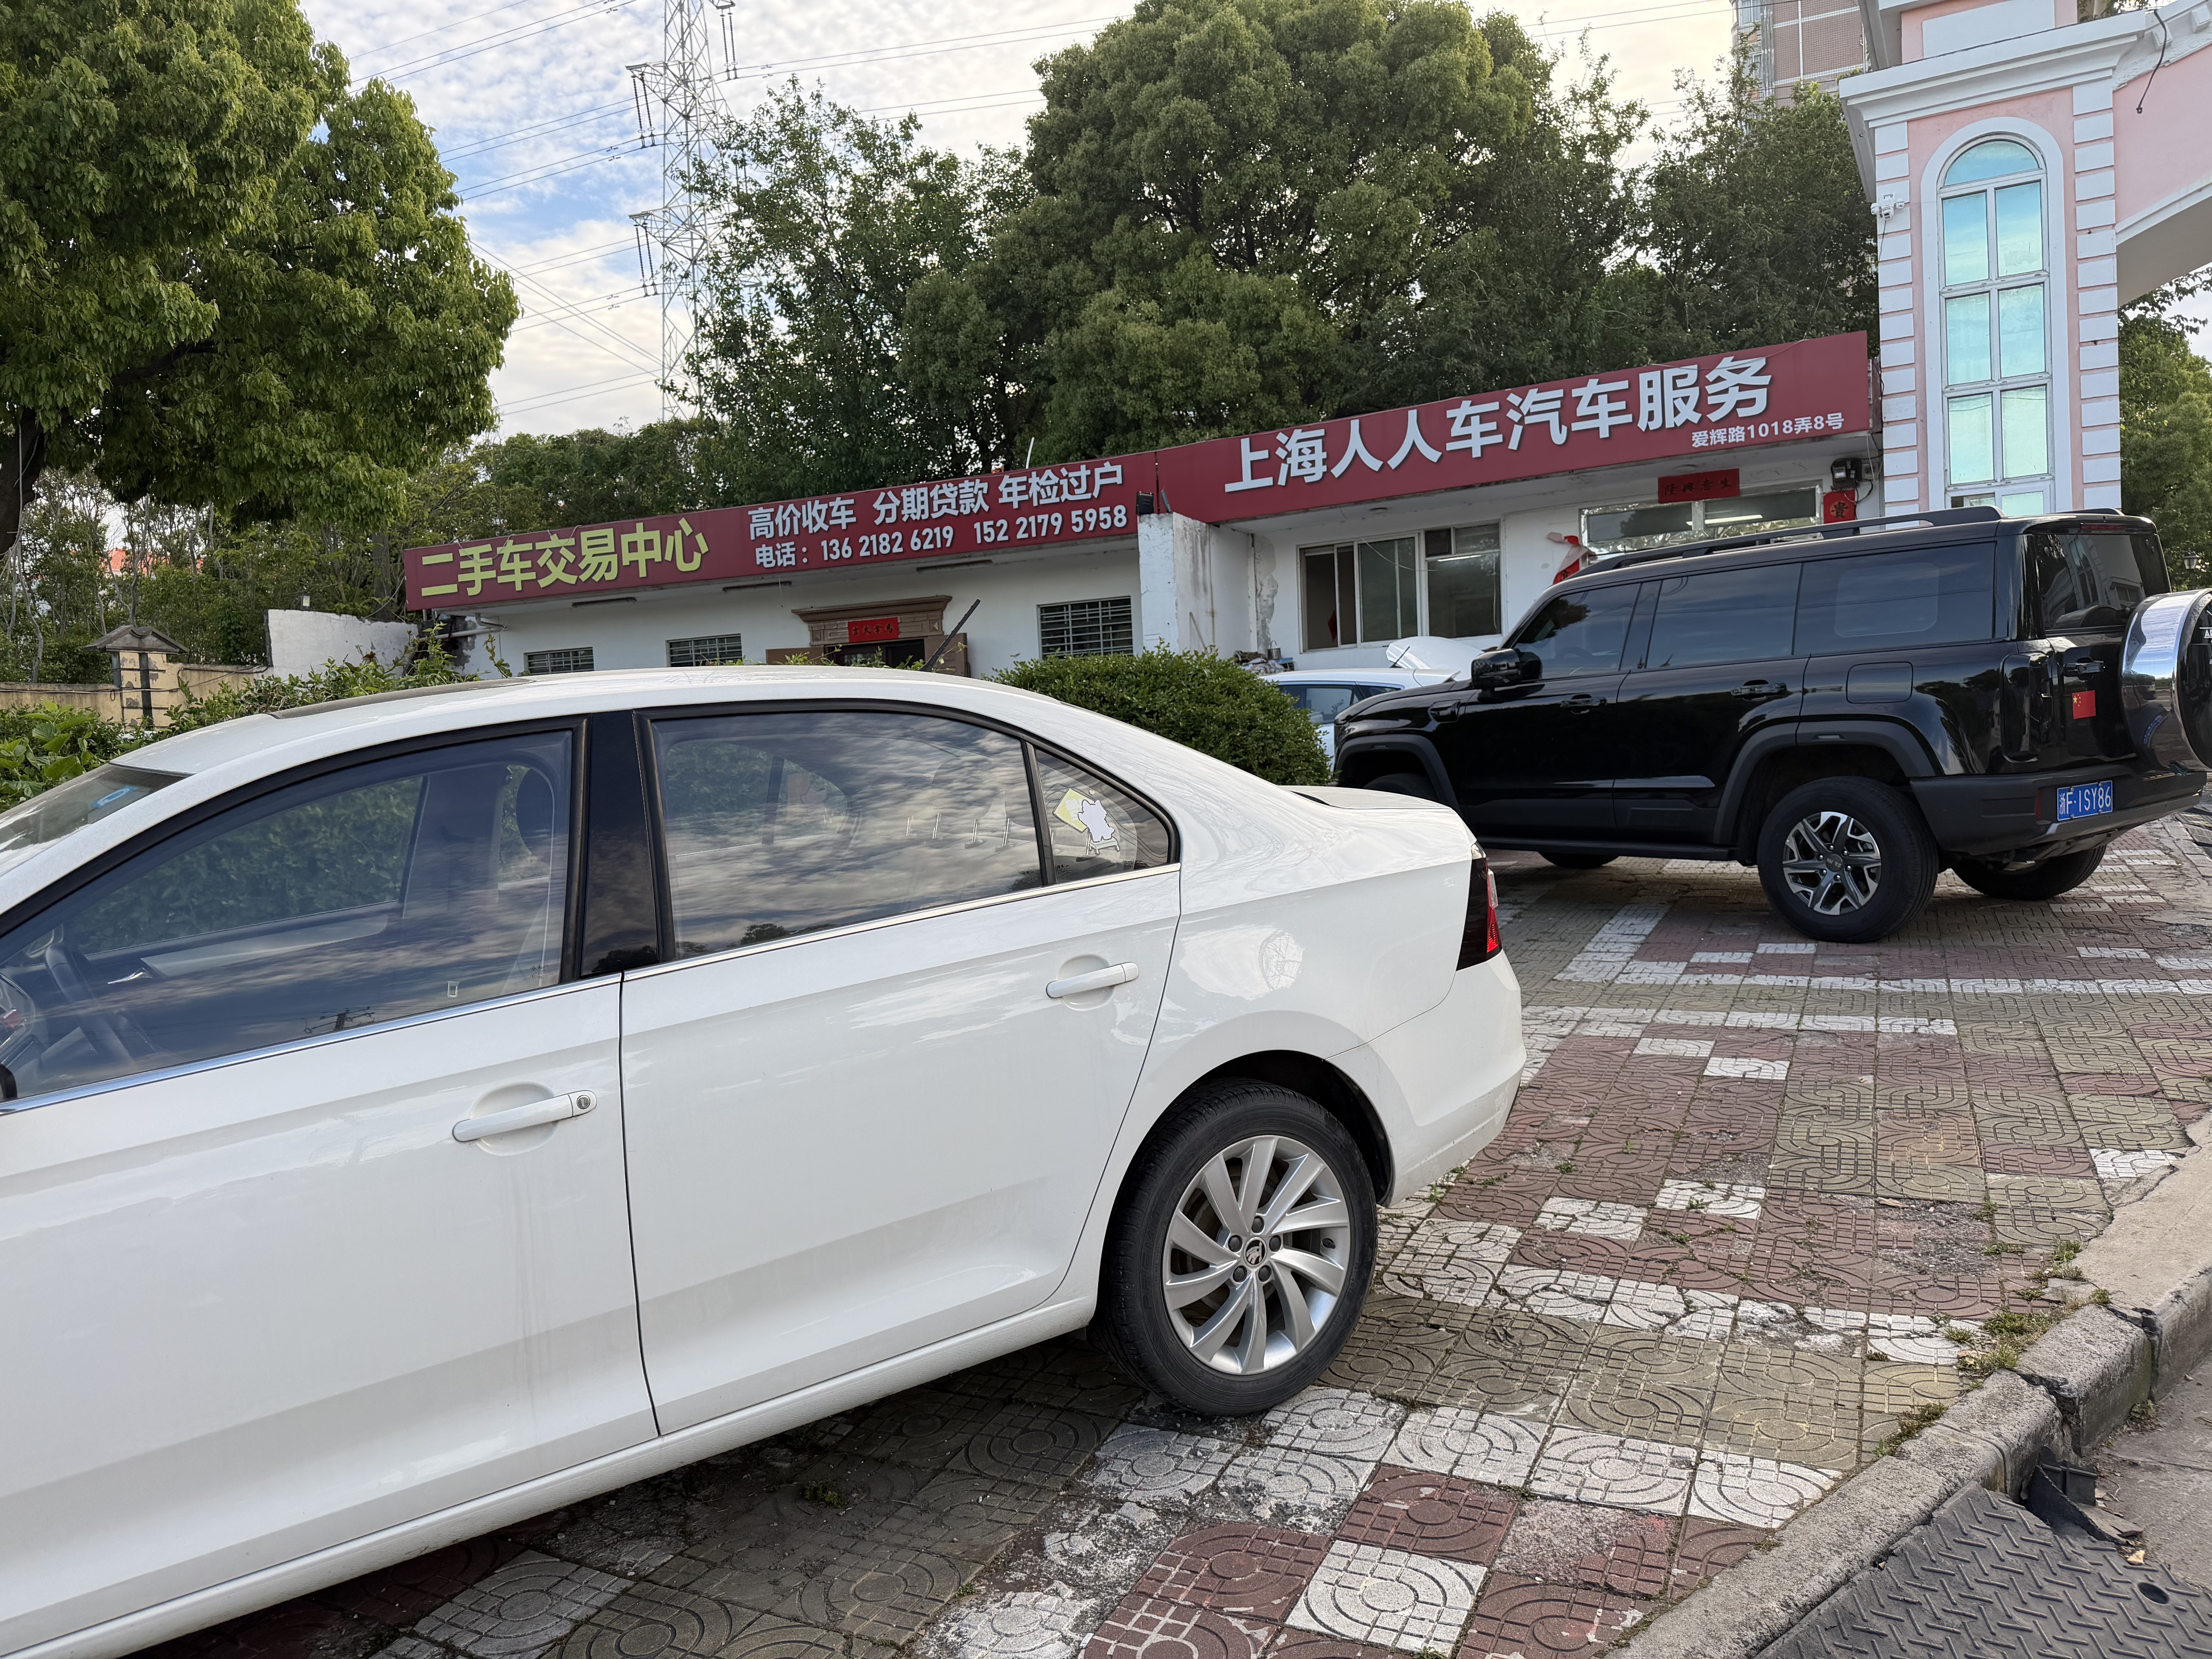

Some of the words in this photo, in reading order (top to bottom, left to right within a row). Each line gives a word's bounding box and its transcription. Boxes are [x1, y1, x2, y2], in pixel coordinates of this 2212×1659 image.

[1225, 356, 1772, 492] 上海人人车汽车服务
[1691, 412, 1844, 448] 爱辉路1018弄8号
[748, 497, 857, 540] 高价收车
[872, 479, 990, 526] 分期贷款
[998, 461, 1123, 509] 年检过户
[821, 537, 852, 561] 136
[858, 531, 903, 557] 2182
[910, 526, 954, 551] 6219
[974, 519, 1009, 544] 152
[1016, 512, 1063, 539] 2179
[1071, 505, 1127, 533] 5958
[421, 517, 709, 597] 二手车交易中心
